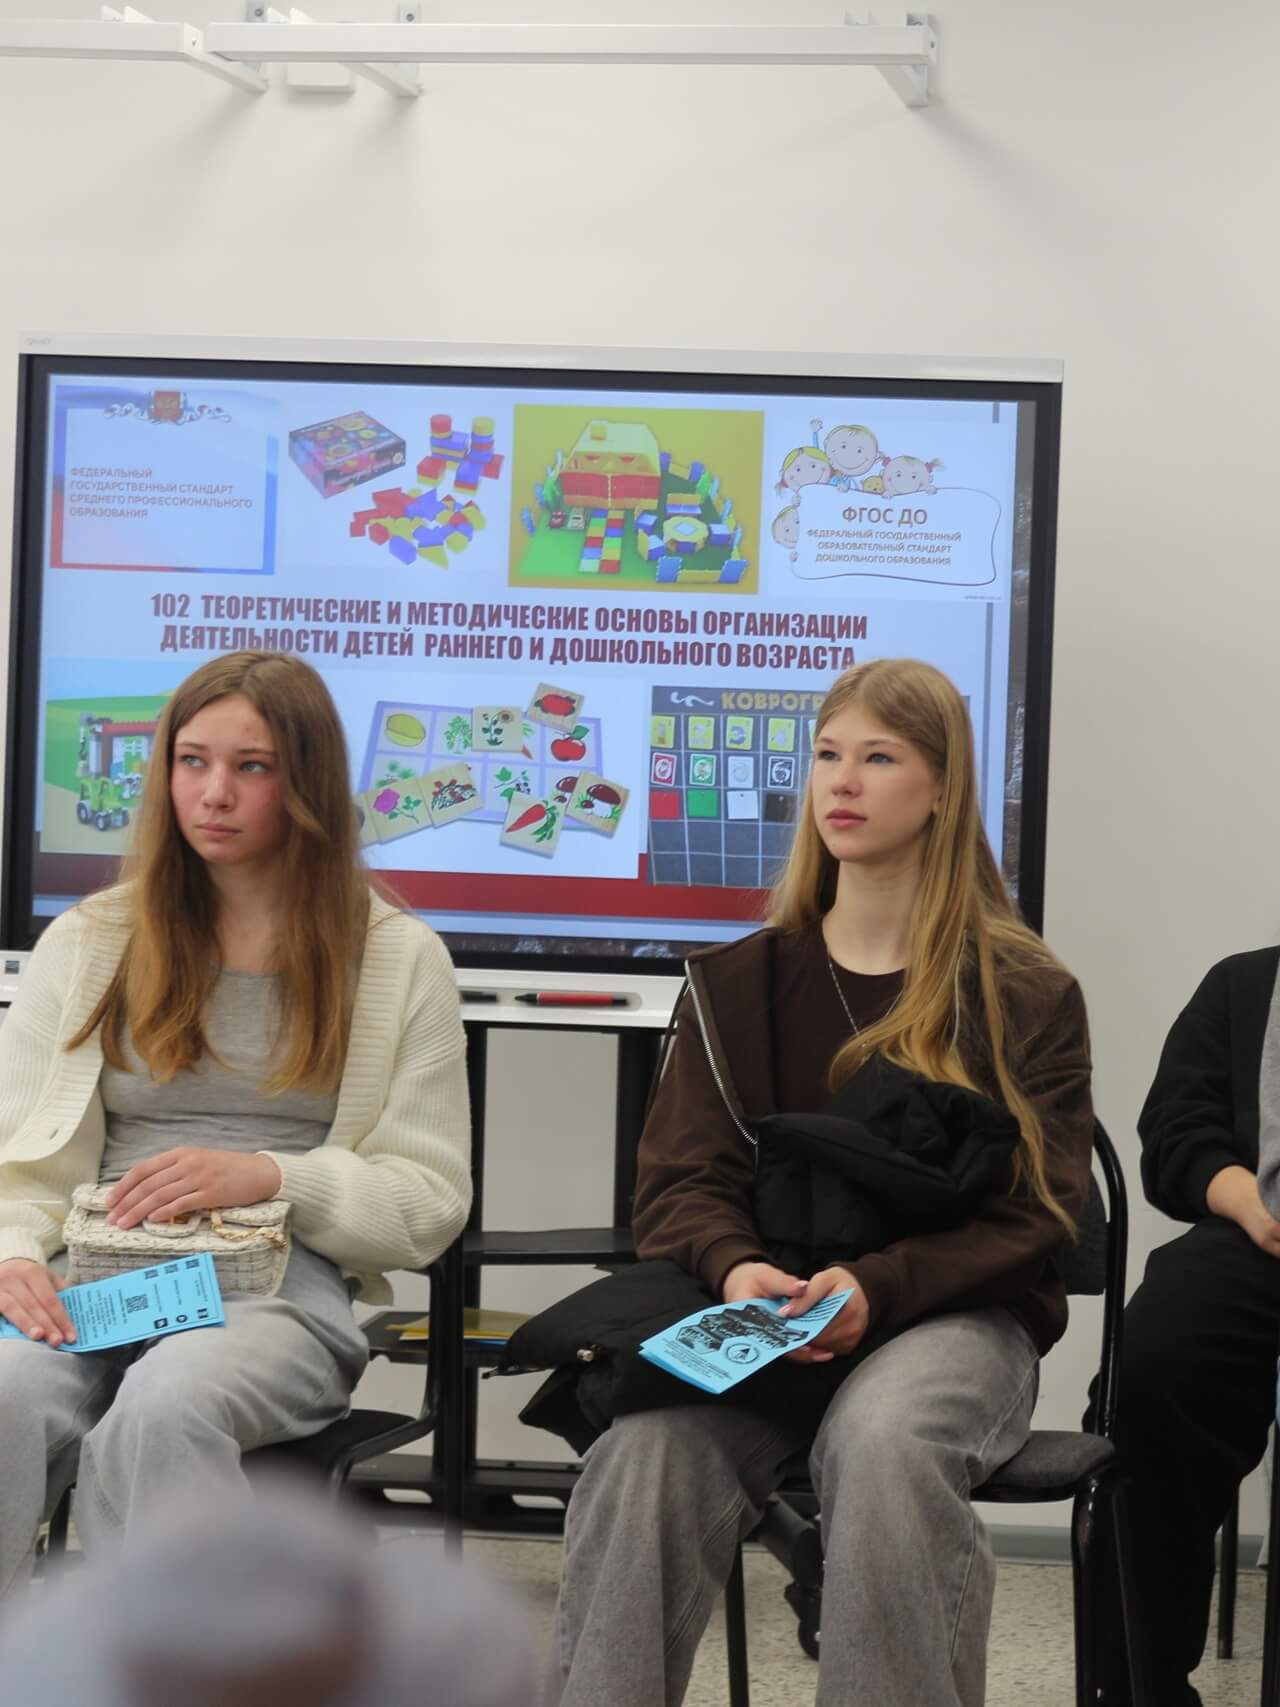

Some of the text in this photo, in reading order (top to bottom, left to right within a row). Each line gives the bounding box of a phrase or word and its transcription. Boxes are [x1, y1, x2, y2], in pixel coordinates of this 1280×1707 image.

[71, 468, 152, 478] ФЕДЕРАЛЬНЫЙ
[70, 480, 234, 494] ГОСУДАРСТВЕННЫЙ СТАНДАРТ
[70, 494, 252, 508] СРЕДНЕГО ПРОФЕССИОНАЛЬНОГО
[70, 507, 148, 518] ОБРАЗОВАНИЯ
[842, 506, 928, 527] ФГОС ДО
[807, 529, 961, 541] ФЕДЕРАЛЬНЫЙ ГОСУДАРСТВЕННЫЙ
[817, 541, 952, 554] ОБРАЗОВАТЕЛЬНЫЙ СТАНДАРТ
[815, 553, 951, 565] ДОШКОЛЬНОГО ОБРАЗОВАНИЯ
[151, 593, 867, 642] 102 ТЕОРЕТИЧЕСКИЕ И МЕТОДИЧЕСКИЕ ОСНОВЫ ОРГАНИЗАЦИИ
[160, 624, 856, 670] ДЕЯТЕЛЬНОСТИ ДЕТЕЙ РАННЕГО И ДОШКОЛЬНОГО ВОЗРАСТА
